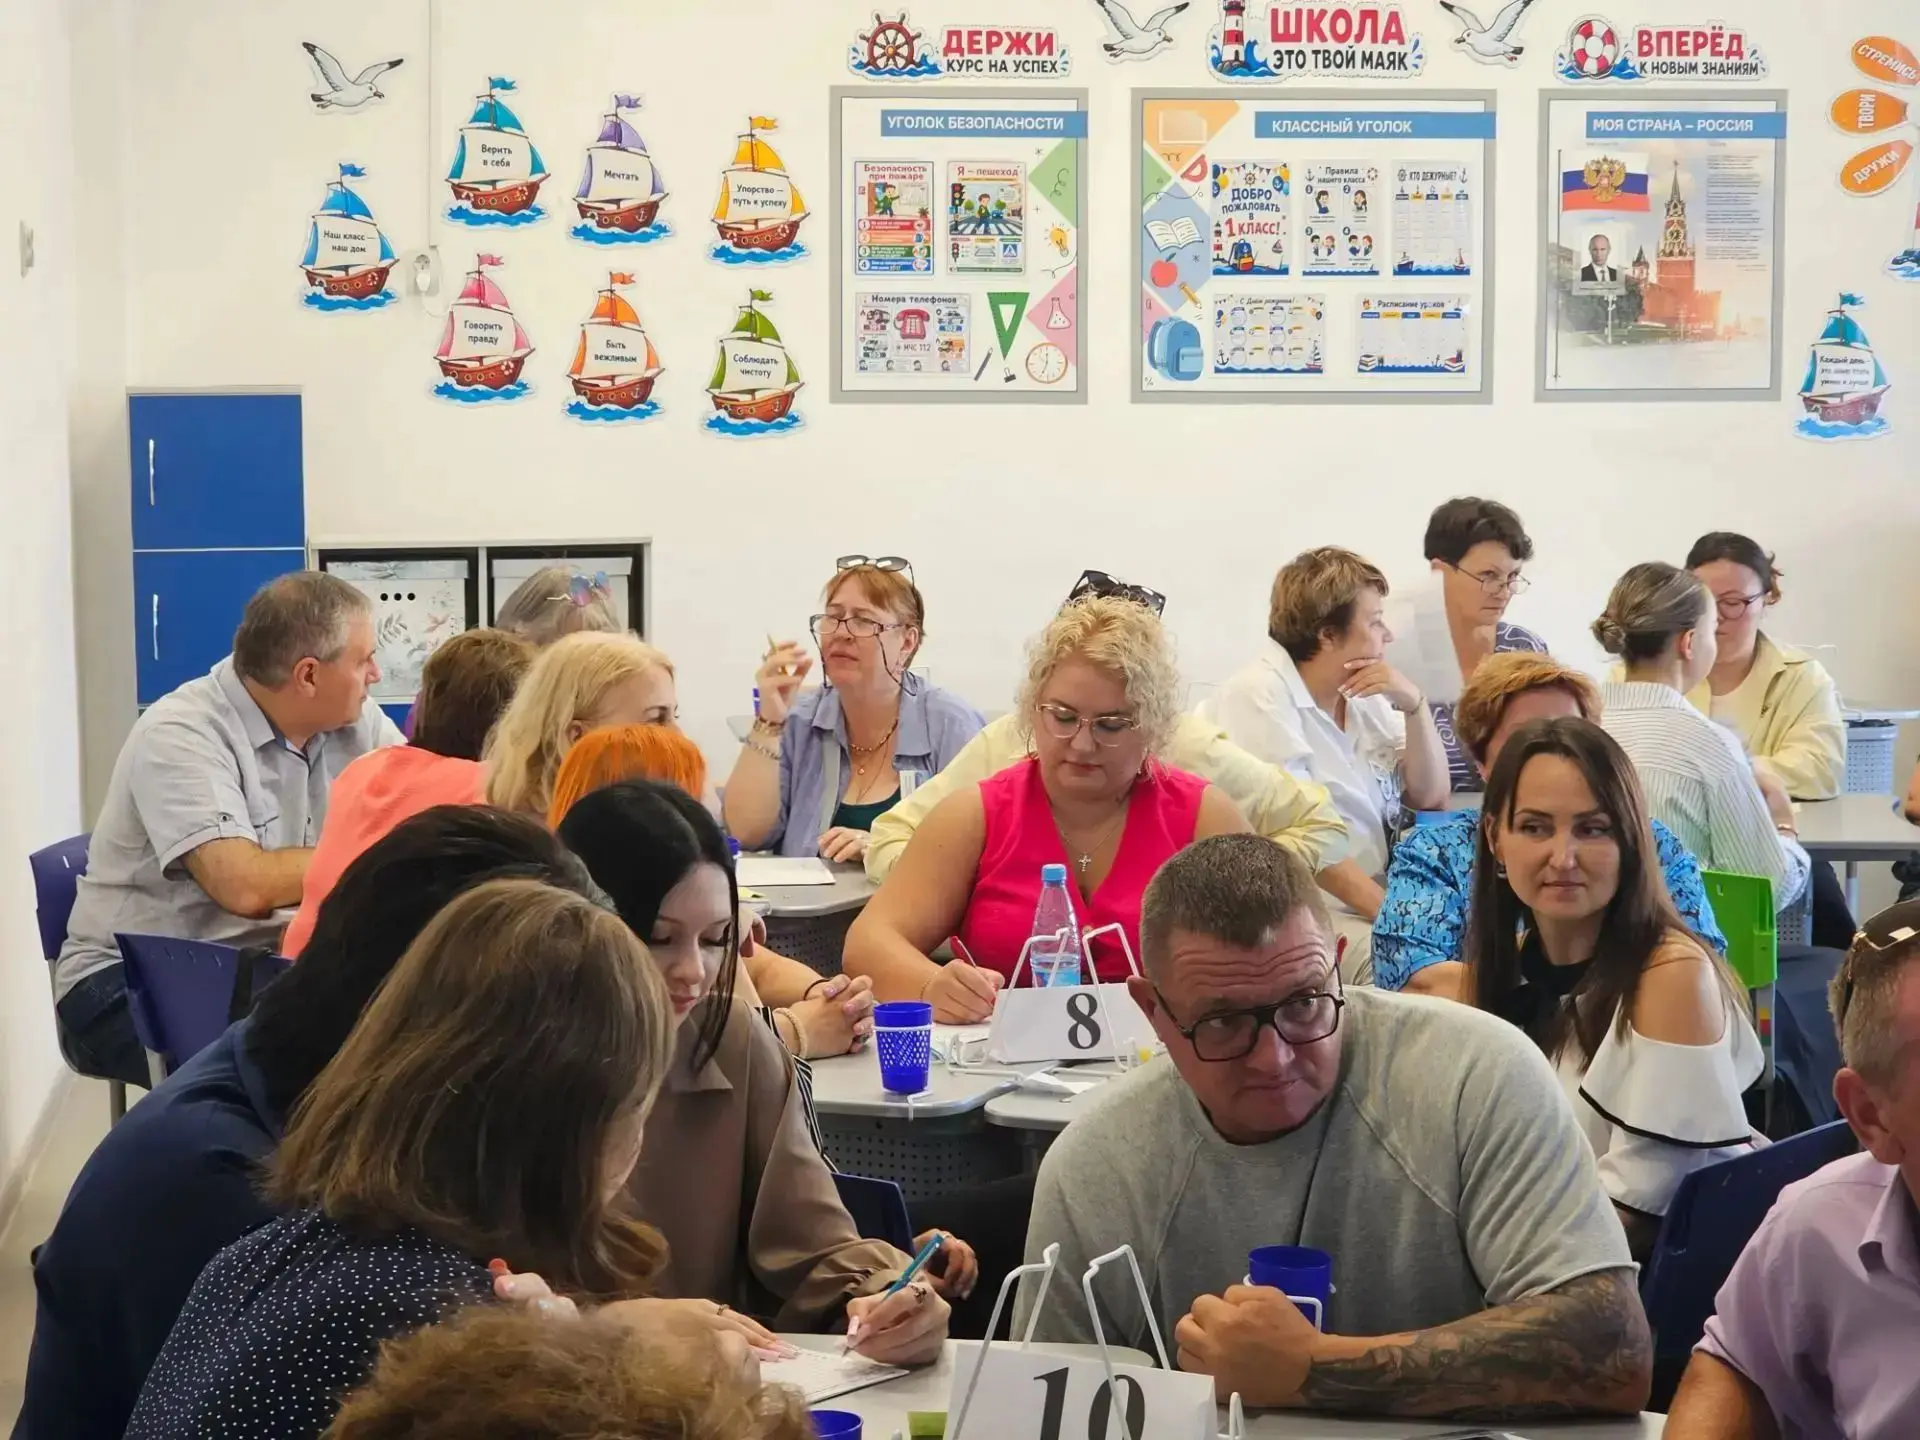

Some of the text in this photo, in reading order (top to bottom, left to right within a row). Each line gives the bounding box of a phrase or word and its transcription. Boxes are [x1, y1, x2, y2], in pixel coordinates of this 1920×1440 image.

[1270, 8, 1405, 45] ШКОЛА
[943, 30, 1054, 57] ДЕРЖИ
[1637, 25, 1744, 60] ВПЕРЁД
[1273, 45, 1408, 71] ЭТО ТВОЙ МАЯК
[1857, 44, 1917, 80] СТРЕМИСЬ
[946, 59, 1058, 73] КУРС НА УСПЕХ
[1640, 62, 1759, 76] К НОВЫМ ЗНАНИЯМ
[1857, 94, 1876, 129] ТВОРИ
[887, 116, 1065, 130] УГОЛОК БЕЗОПАСНОСТИ
[1272, 117, 1412, 133] КЛАССНЫЙ УГОЛОК
[1593, 119, 1624, 132] МОЯ
[1627, 119, 1682, 132] СТРАНА
[1697, 119, 1754, 132] РОССИЯ
[481, 144, 513, 155] Верить
[491, 158, 511, 167] себя
[864, 164, 928, 172] Безопасность
[1853, 150, 1900, 184] ДРУЖИ
[604, 169, 639, 181] Мечтать
[957, 166, 965, 176] Я
[976, 168, 1019, 177] пешеход
[1325, 167, 1359, 175] Правила
[1409, 171, 1420, 181] КТО
[869, 173, 925, 182] при пожаре
[1317, 177, 1342, 185] нашего
[737, 184, 775, 195] Упорство
[1231, 188, 1272, 202] ДОБРО
[733, 198, 751, 207] путь
[760, 200, 787, 209] успеху
[1222, 202, 1281, 214] ПОЖАЛОВАТЬ
[1225, 217, 1281, 238] 1 КЛАСС!
[323, 230, 341, 239] Наш
[871, 295, 957, 305] Номера телефонов
[1378, 300, 1418, 308] Расписание
[464, 320, 503, 331] Говорить
[468, 335, 499, 345] правду
[606, 340, 626, 349] Быть
[594, 354, 637, 362] вежливым
[733, 353, 779, 365] Соблюдать
[740, 369, 771, 379] чистоту
[1066, 993, 1101, 1049] 8
[1033, 1367, 1145, 1440] 10
